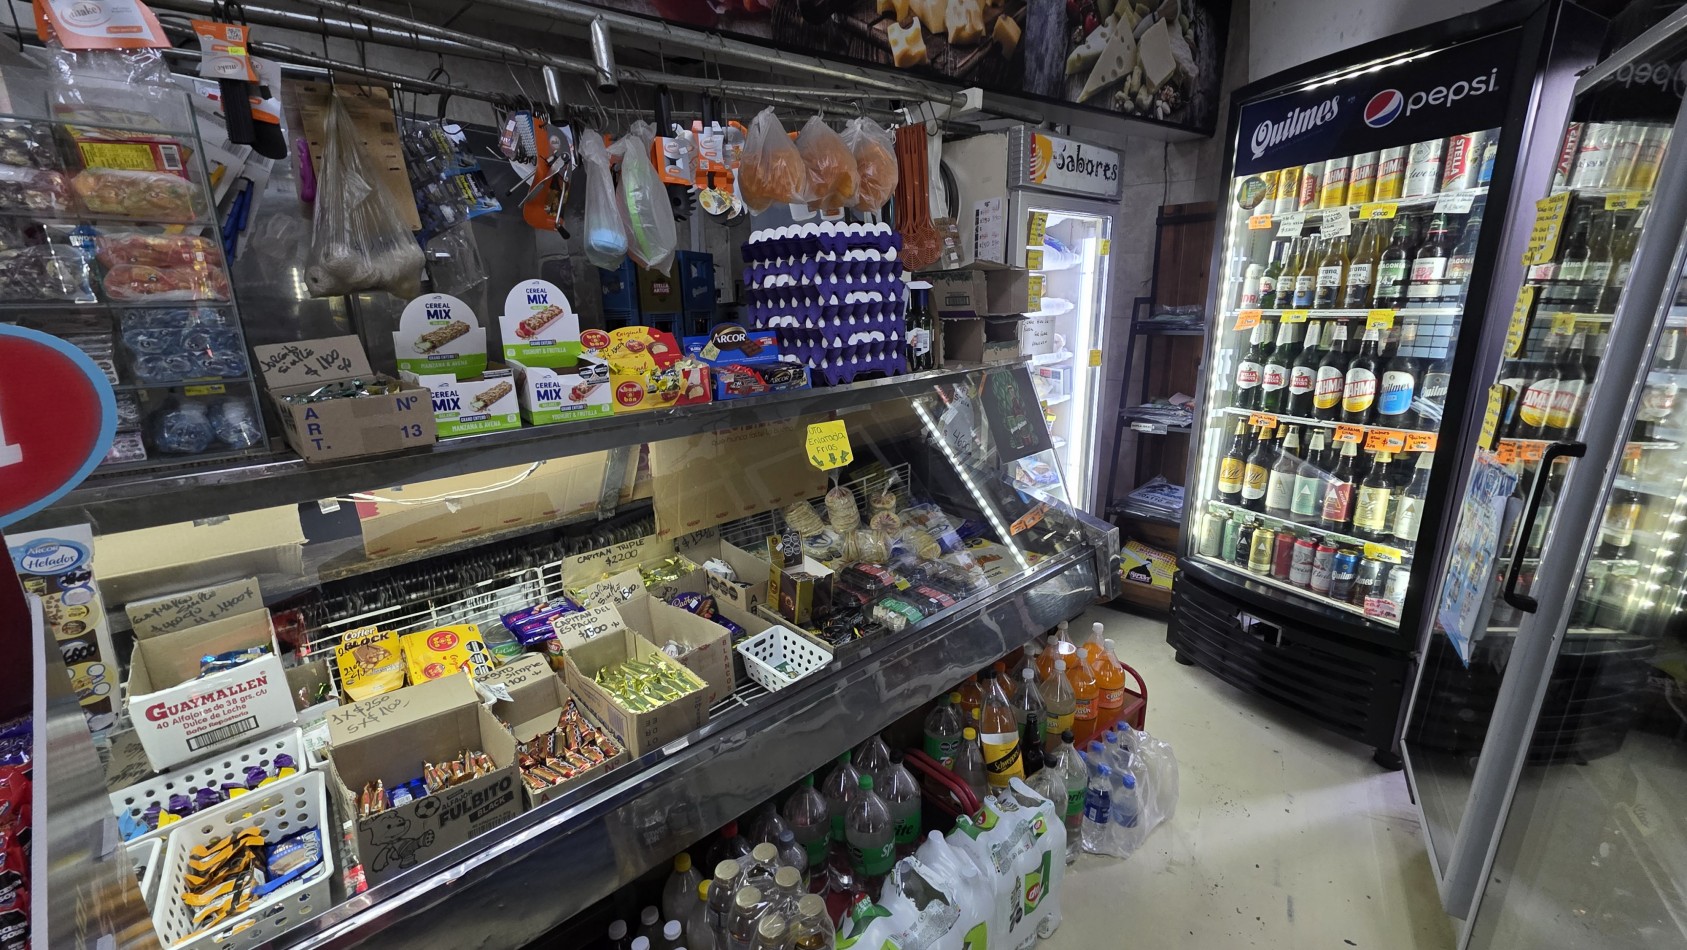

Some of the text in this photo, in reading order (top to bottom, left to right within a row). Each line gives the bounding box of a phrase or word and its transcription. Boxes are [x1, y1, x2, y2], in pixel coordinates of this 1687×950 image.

[1406, 67, 1498, 116] pepsi
[1251, 95, 1340, 160] Quilmes
[1451, 138, 1465, 176] STELLA
[527, 294, 548, 304] MIX
[427, 309, 452, 320] MIX
[616, 328, 643, 338] Original
[713, 333, 746, 343] ARCOR
[537, 388, 562, 401] MIX
[1344, 380, 1376, 398] RAHMA
[1421, 386, 1448, 398] Quilm
[433, 398, 461, 412] MIX
[401, 424, 422, 438] 13
[451, 422, 478, 432] MANZANA
[484, 420, 501, 428] AVENA
[27, 544, 60, 556] ARCOR
[577, 539, 645, 564] CAPITAN TRIPLE
[605, 550, 638, 567] $2200
[28, 553, 75, 569] Helados
[554, 610, 592, 629] CAPITAN
[596, 605, 611, 616] DEL
[559, 617, 598, 635] ESPACIO
[344, 628, 375, 641] Cofler
[345, 632, 389, 651] BLOCK
[145, 675, 268, 722] GUAYMALLEN
[157, 721, 169, 730] 40
[172, 707, 213, 726] Alfajores
[213, 703, 225, 711] de
[226, 699, 237, 707] 38
[240, 694, 255, 704] grs.
[183, 704, 247, 729] Dulce de Leche
[439, 776, 512, 828] FULBITO
[442, 789, 473, 810] ALFAJOR
[477, 796, 506, 817] BLACK
